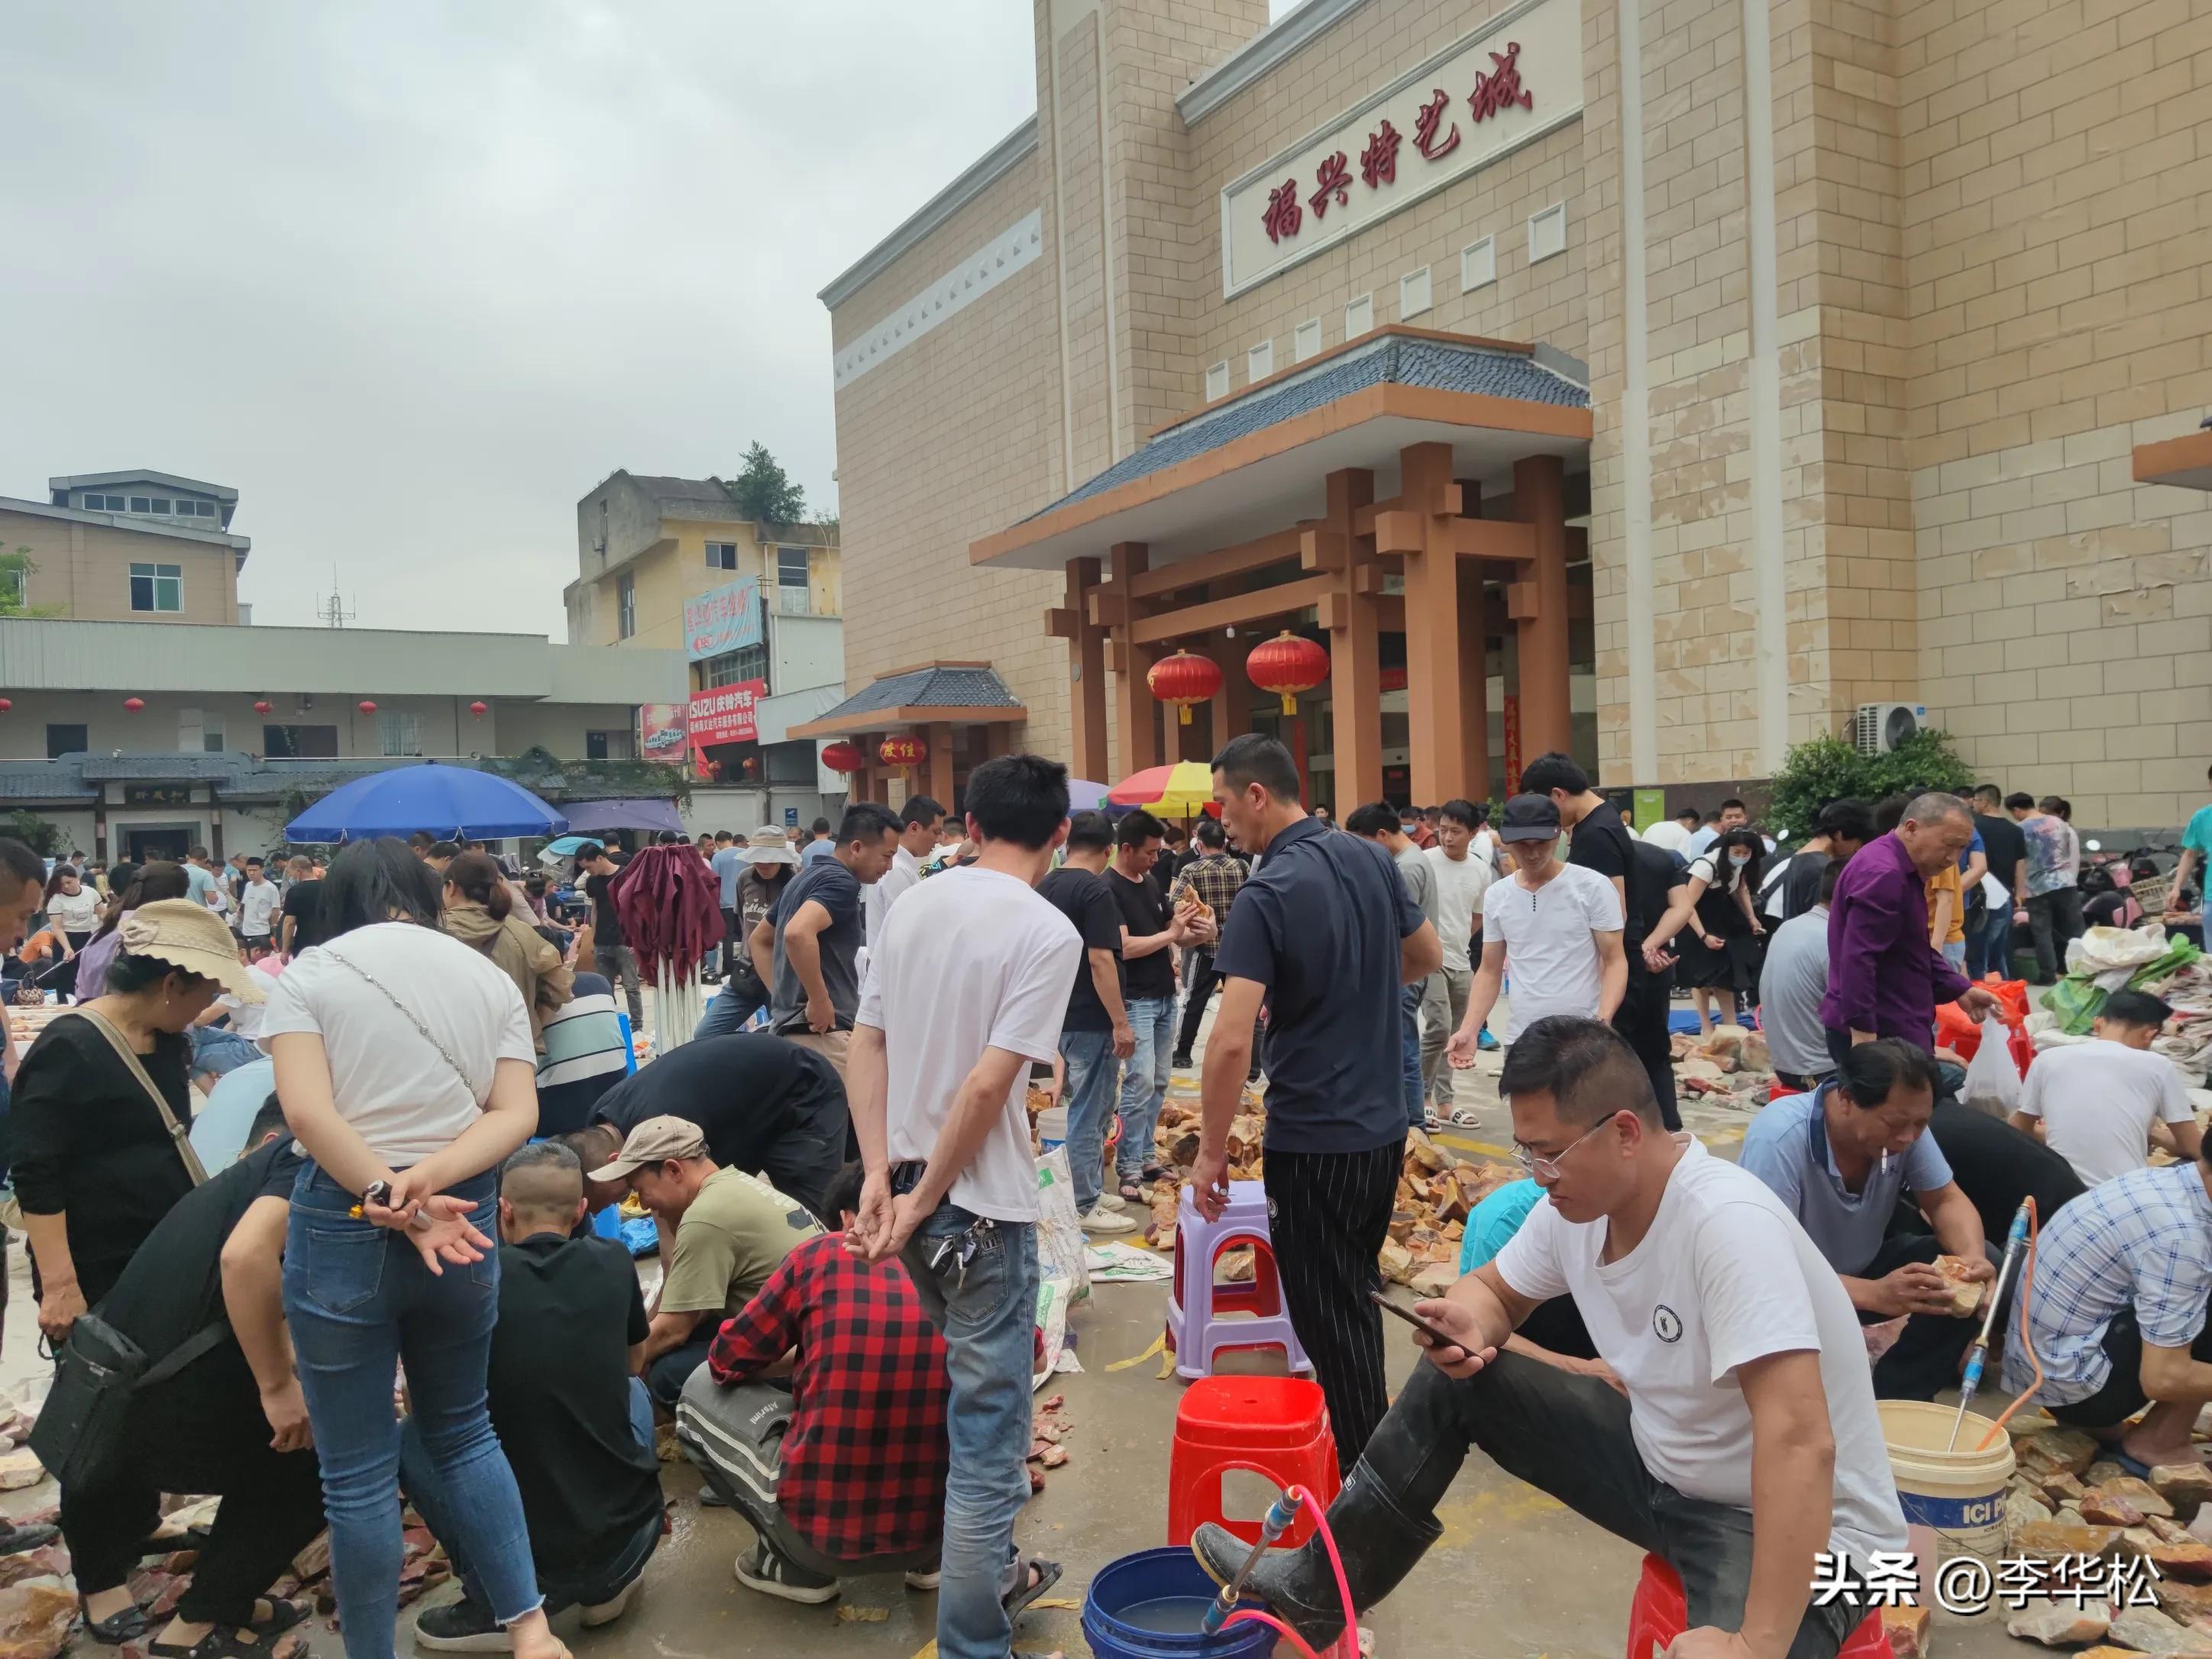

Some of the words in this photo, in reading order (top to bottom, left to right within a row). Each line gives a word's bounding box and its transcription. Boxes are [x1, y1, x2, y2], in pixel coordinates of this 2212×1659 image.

[1262, 42, 1532, 244] 福兴特艺城
[689, 697, 716, 719] ISUZU
[716, 690, 752, 713] 庆铃汽车
[1963, 1502, 1990, 1524] ICI
